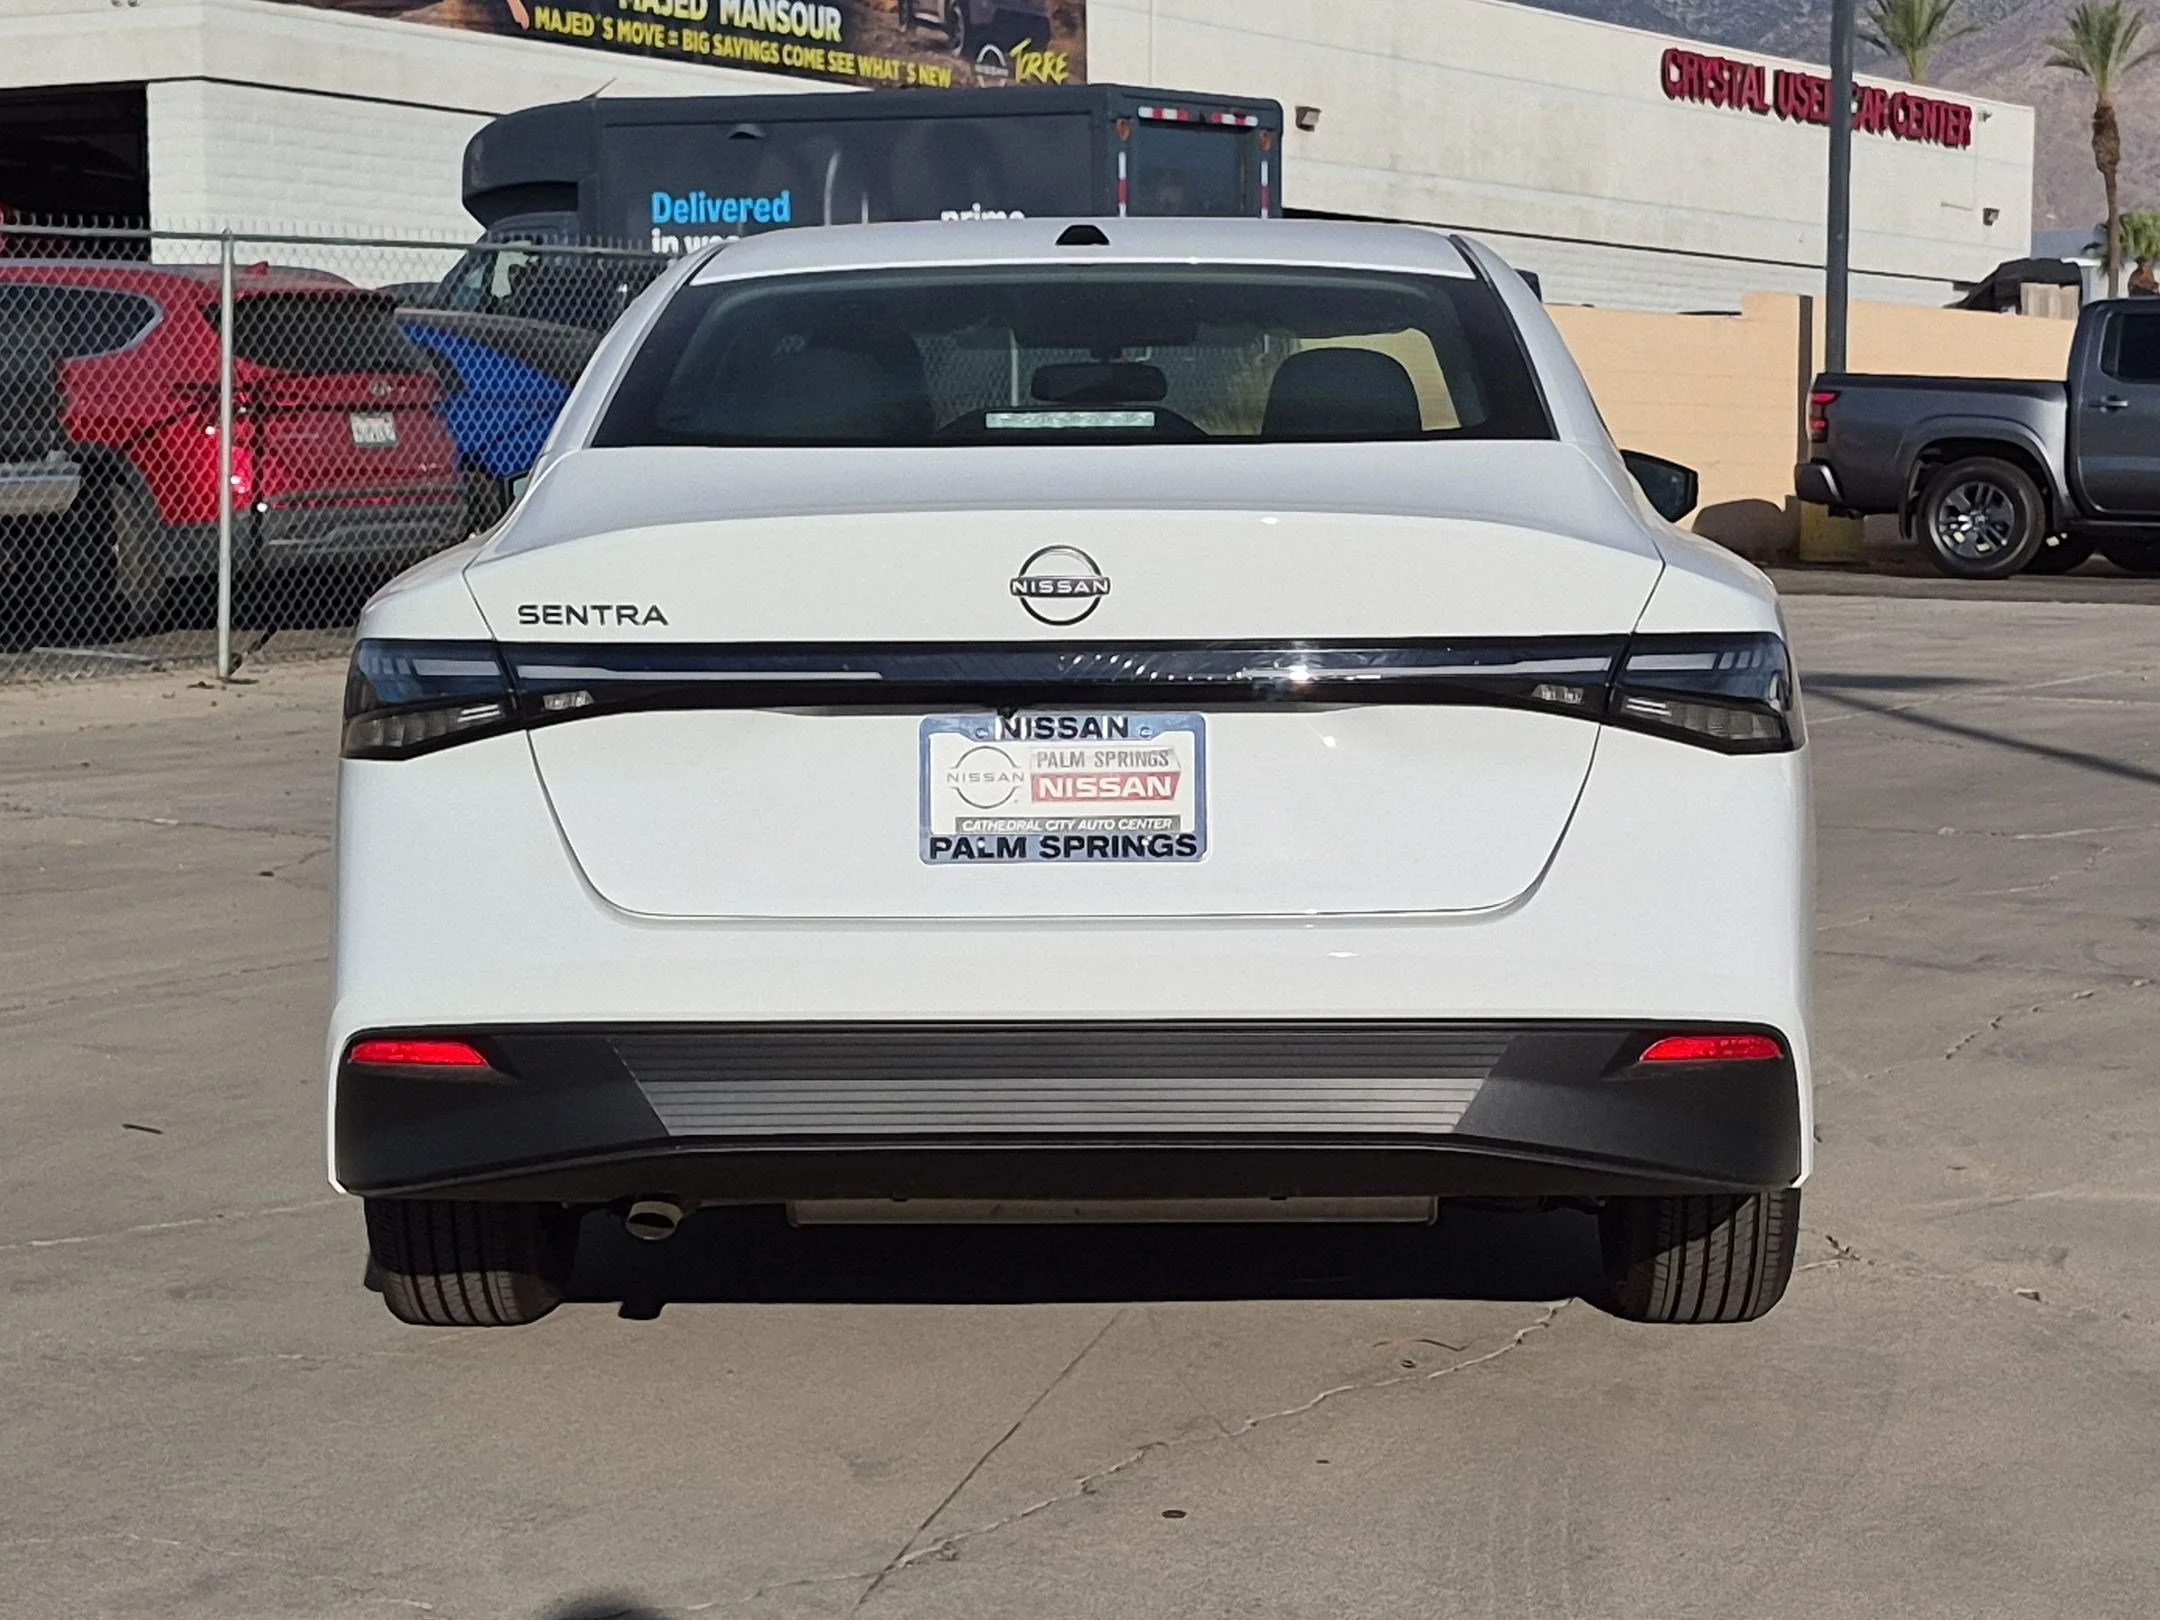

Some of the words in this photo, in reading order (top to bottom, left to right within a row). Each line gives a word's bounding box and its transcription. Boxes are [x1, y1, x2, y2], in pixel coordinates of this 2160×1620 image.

[720, 0, 842, 43] MANSOUR
[617, 18, 665, 48] MOVE
[682, 28, 709, 54] BIG
[712, 33, 780, 64] SAVINGS
[782, 43, 825, 71] COME
[827, 50, 856, 75] SEE
[919, 64, 952, 88] NEW
[1661, 48, 1771, 116] CRYSTAL
[1889, 92, 1972, 150] CENTER
[651, 190, 791, 223] Delivered
[651, 227, 679, 254] in
[1011, 579, 1109, 594] NISSAN
[518, 604, 669, 626] SENTRA
[999, 716, 1129, 740] NISSAN
[1036, 750, 1085, 768] PALM
[1094, 749, 1170, 768] SPRINGS
[946, 772, 1025, 783] NISSAN
[1039, 775, 1172, 799] NISSAN
[962, 820, 1041, 832] CATHEDRAL
[1045, 819, 1075, 831] CITY
[1078, 818, 1115, 831] AUTO
[1118, 817, 1173, 830] CENTER
[930, 836, 1027, 860] PALM
[1039, 834, 1197, 859] SPRINGS
